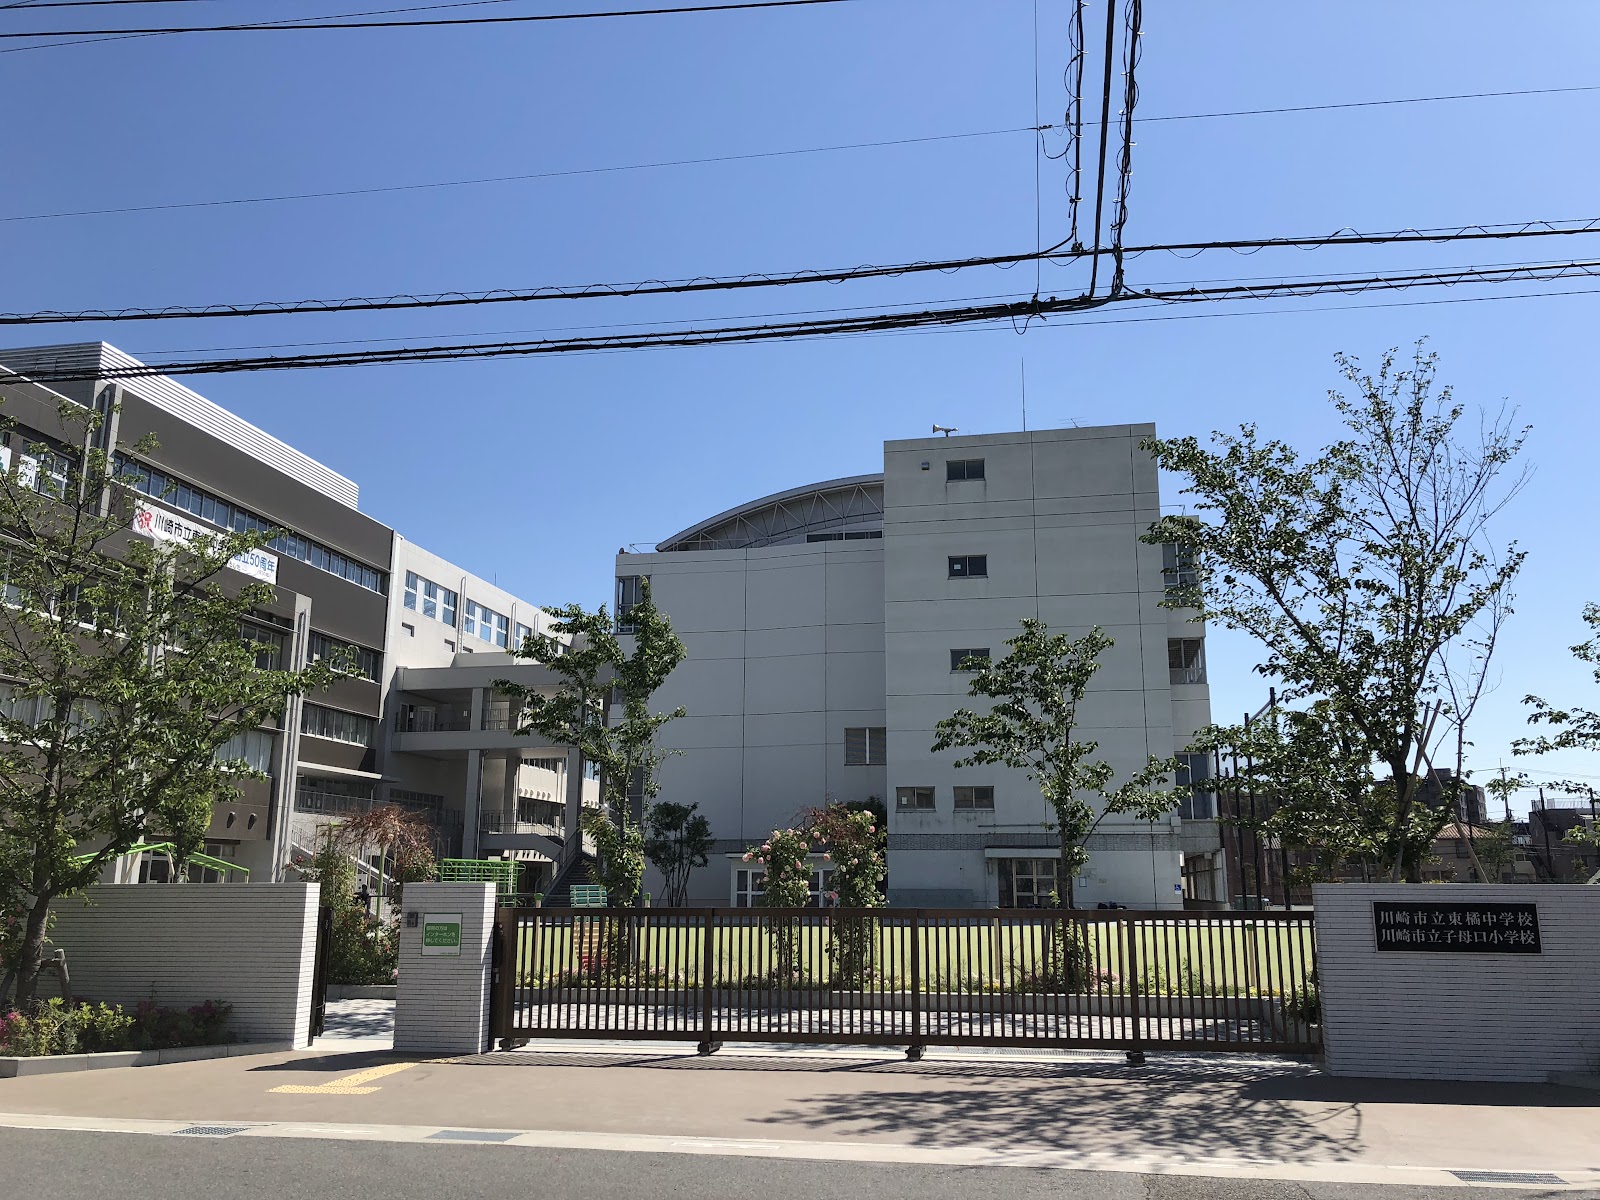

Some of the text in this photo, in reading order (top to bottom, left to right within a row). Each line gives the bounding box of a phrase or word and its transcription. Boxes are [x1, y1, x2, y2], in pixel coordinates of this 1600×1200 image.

[1379, 910, 1534, 927] 川崎市立東橘中学校
[1381, 928, 1536, 945] 川崎市立子母口小学校
